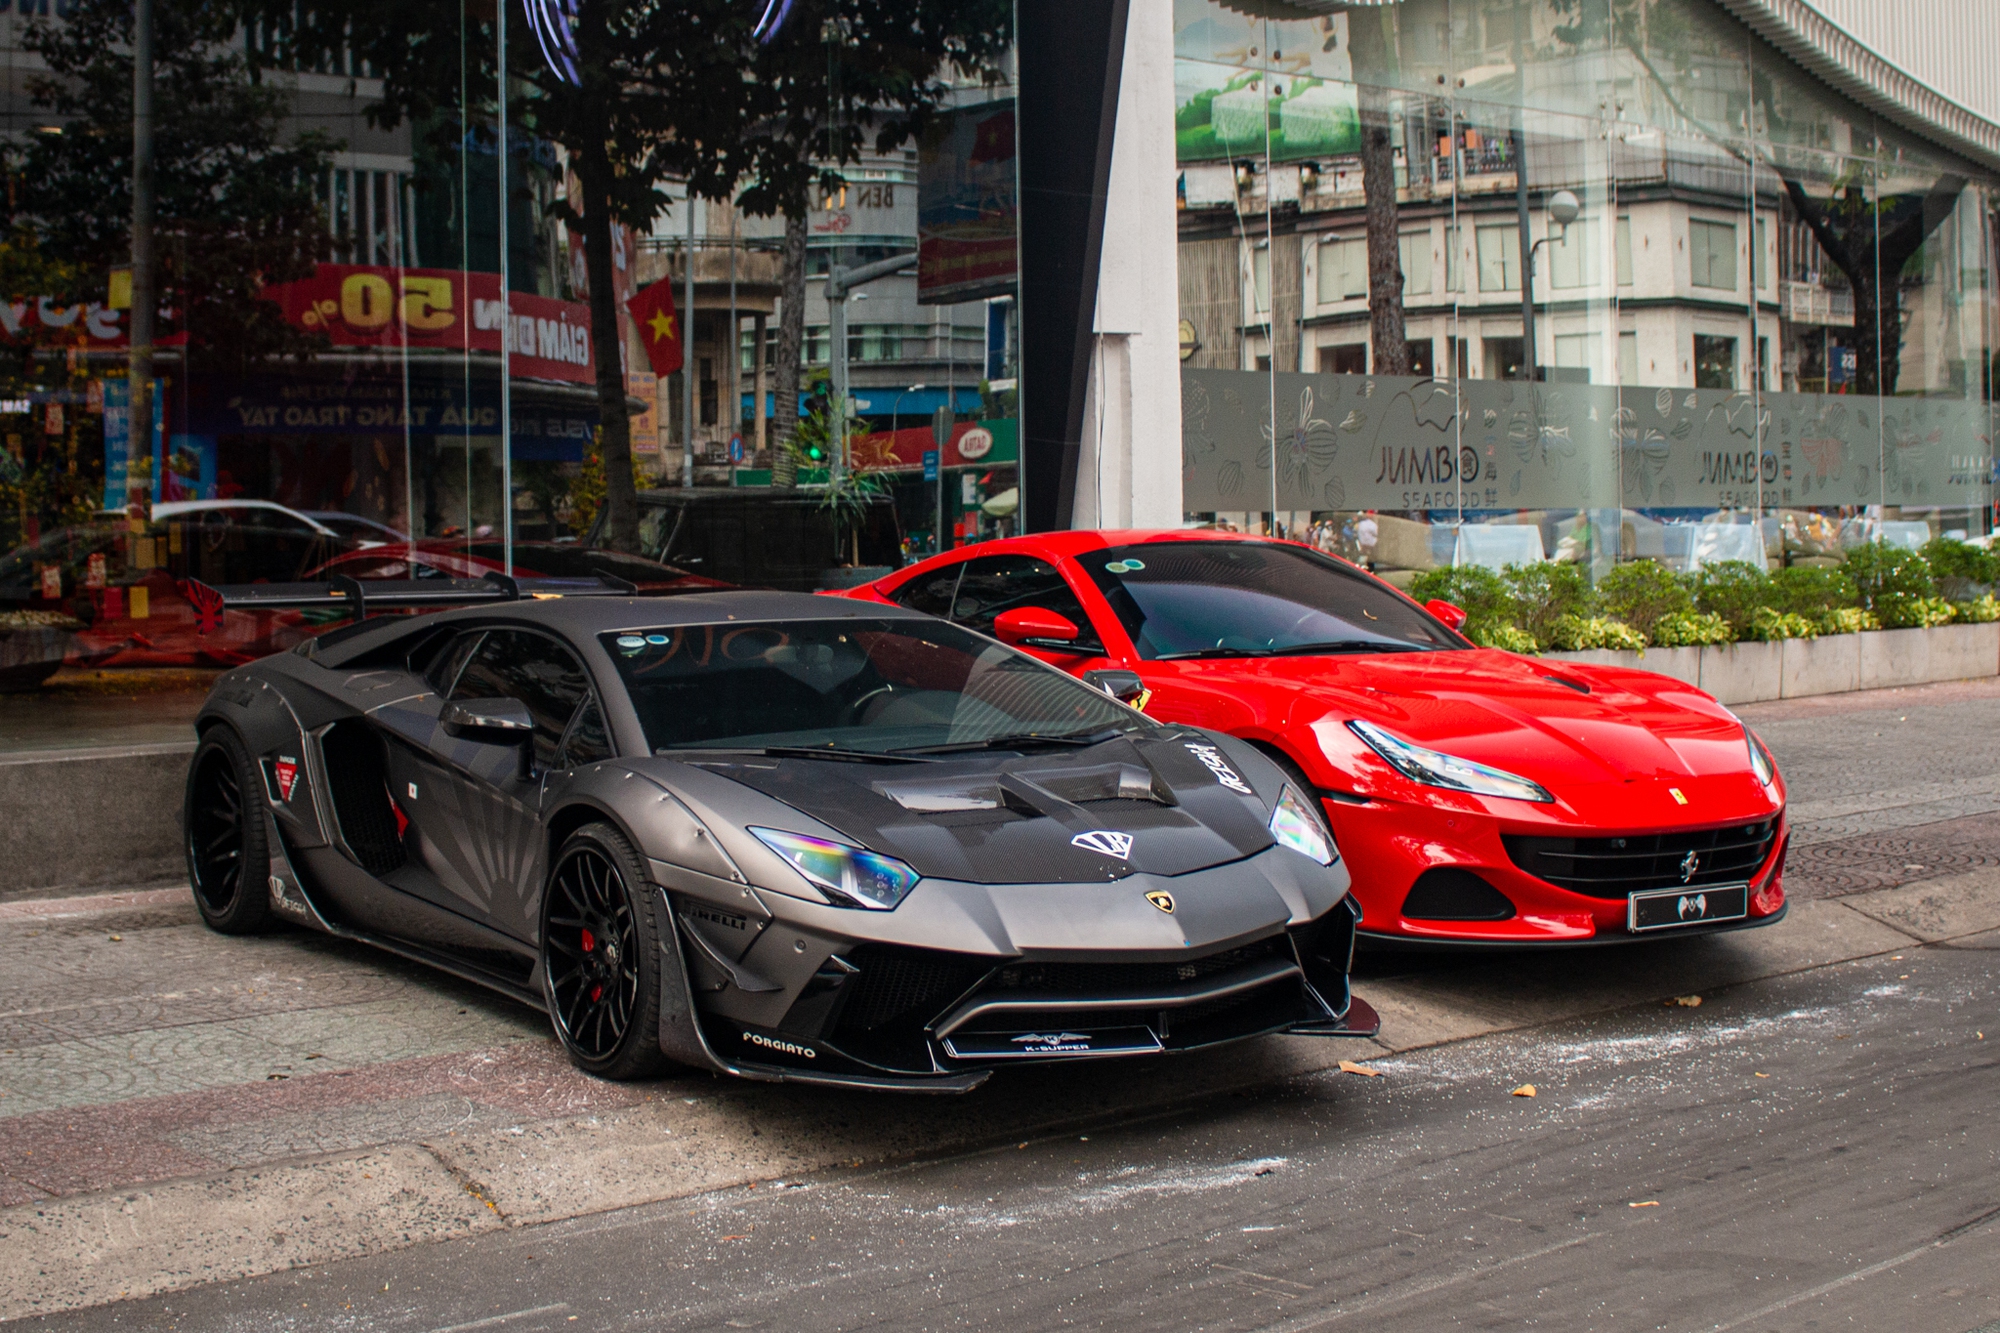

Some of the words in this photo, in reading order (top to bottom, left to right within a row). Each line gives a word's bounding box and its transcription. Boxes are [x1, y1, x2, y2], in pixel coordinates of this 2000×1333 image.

[1376, 446, 1479, 484] JUMBO
[1403, 491, 1479, 508] SEAFOOD
[742, 1031, 817, 1059] FORGIATO
[1024, 1043, 1090, 1052] K-SUPPER
